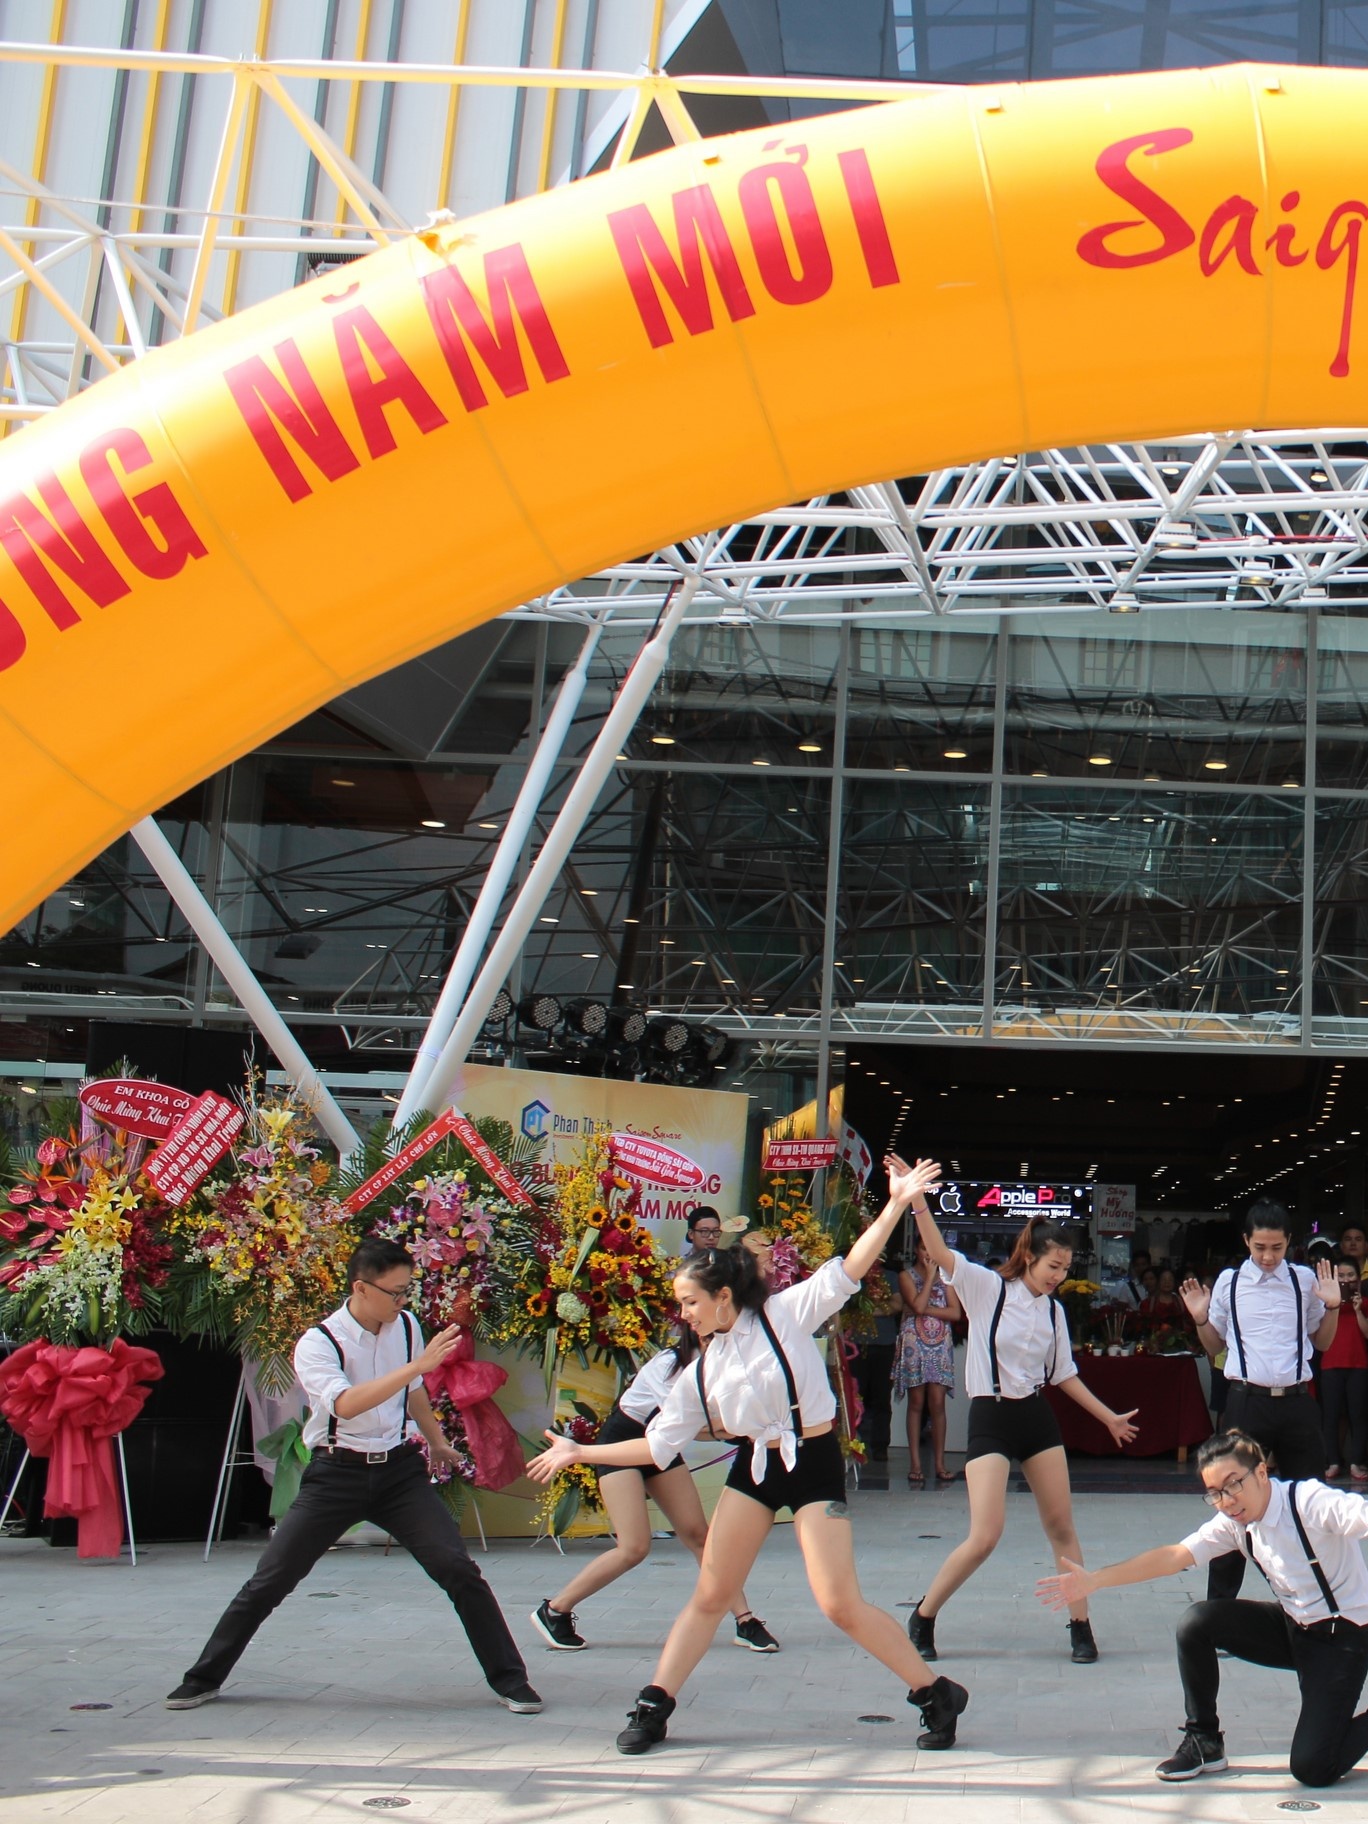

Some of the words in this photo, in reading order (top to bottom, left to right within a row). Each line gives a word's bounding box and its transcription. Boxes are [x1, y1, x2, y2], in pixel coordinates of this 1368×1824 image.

[222, 282, 571, 504] NĂM
[606, 139, 900, 349] MỚI
[114, 1085, 133, 1096] EM
[135, 1089, 169, 1104] KHOA
[110, 1099, 143, 1122] Mừng
[142, 1105, 171, 1126] Khai
[553, 1114, 579, 1133] Phan
[155, 1172, 174, 1191] CTY
[167, 1162, 182, 1177] CP
[175, 1152, 191, 1167] XD
[184, 1140, 200, 1156] TM
[193, 1130, 209, 1145] SX
[199, 1137, 224, 1163] Khai
[624, 1140, 637, 1151] CTY
[635, 1144, 658, 1159] TOYOTA
[357, 1187, 373, 1203] CTY
[371, 1178, 383, 1190] CP
[1007, 1207, 1050, 1218] Accessories
[1051, 1207, 1071, 1218] World
